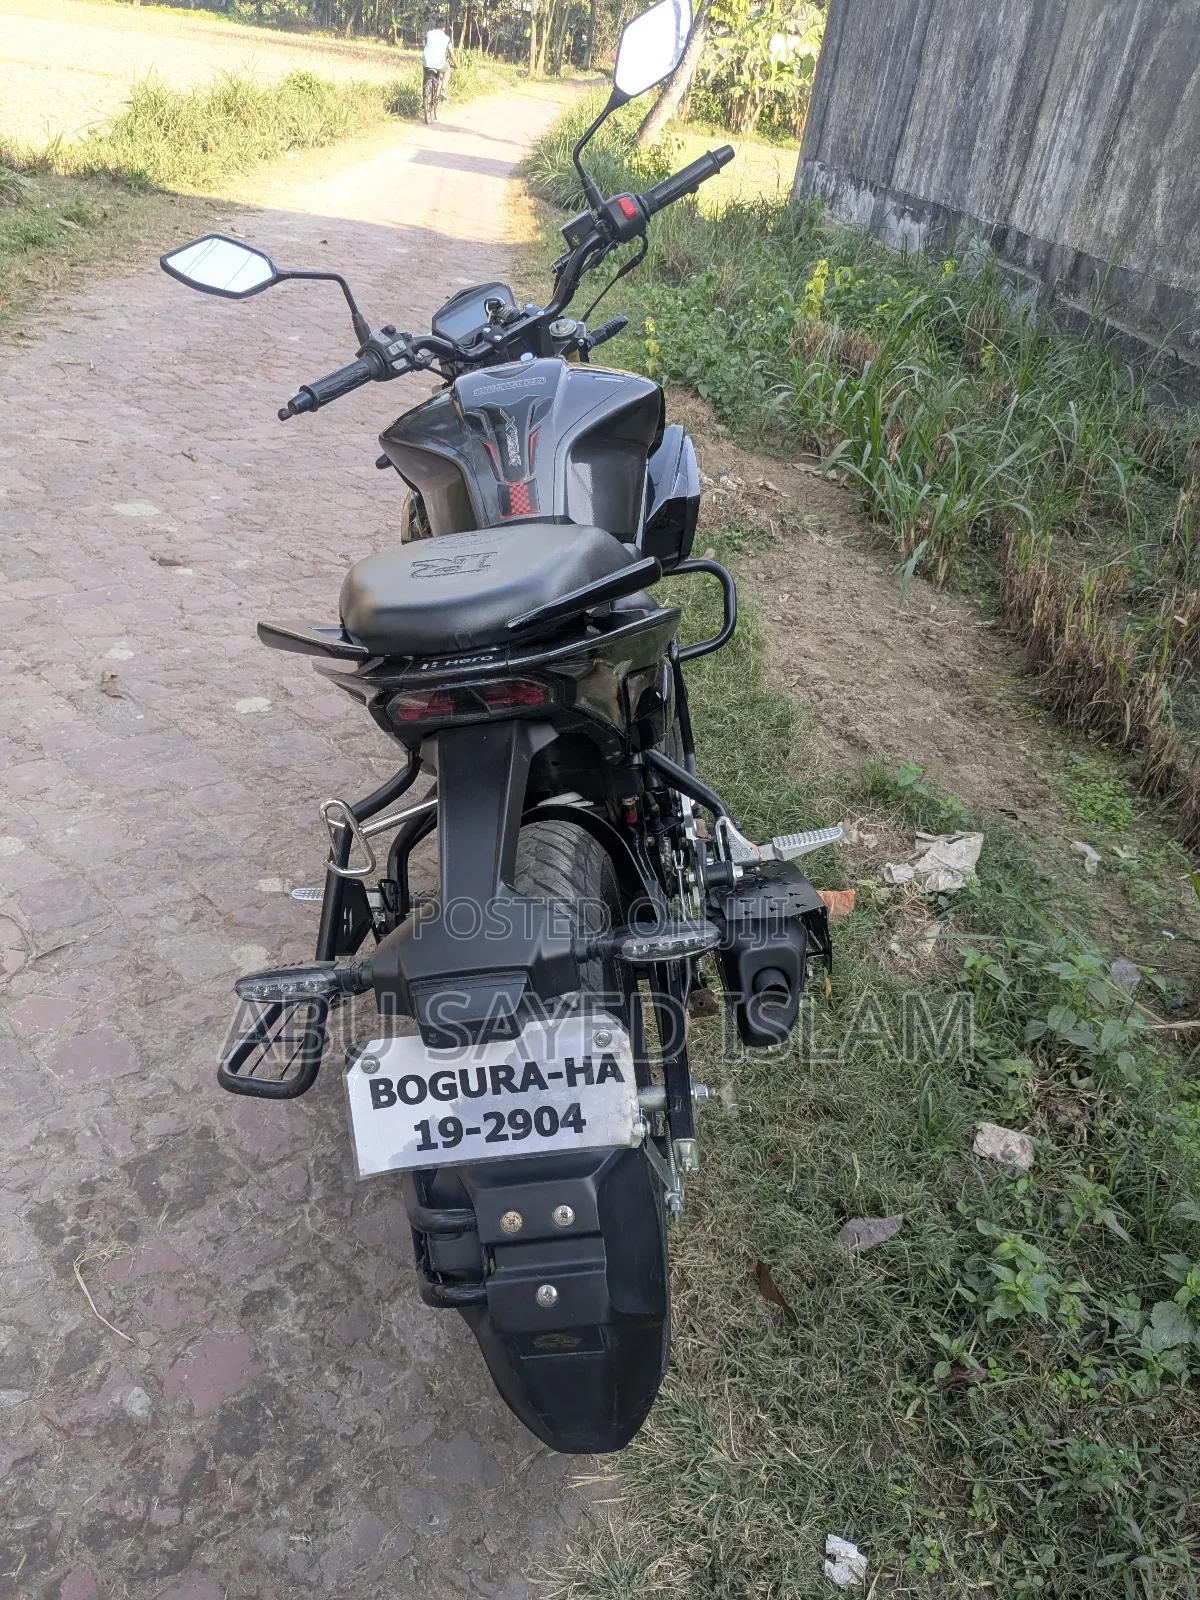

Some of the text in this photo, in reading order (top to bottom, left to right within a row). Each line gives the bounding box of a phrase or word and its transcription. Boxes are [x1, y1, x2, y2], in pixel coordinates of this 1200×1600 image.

[445, 655, 494, 666] Hero
[369, 1053, 625, 1110] BOGURA-HA
[413, 1102, 587, 1152] 19-2904
